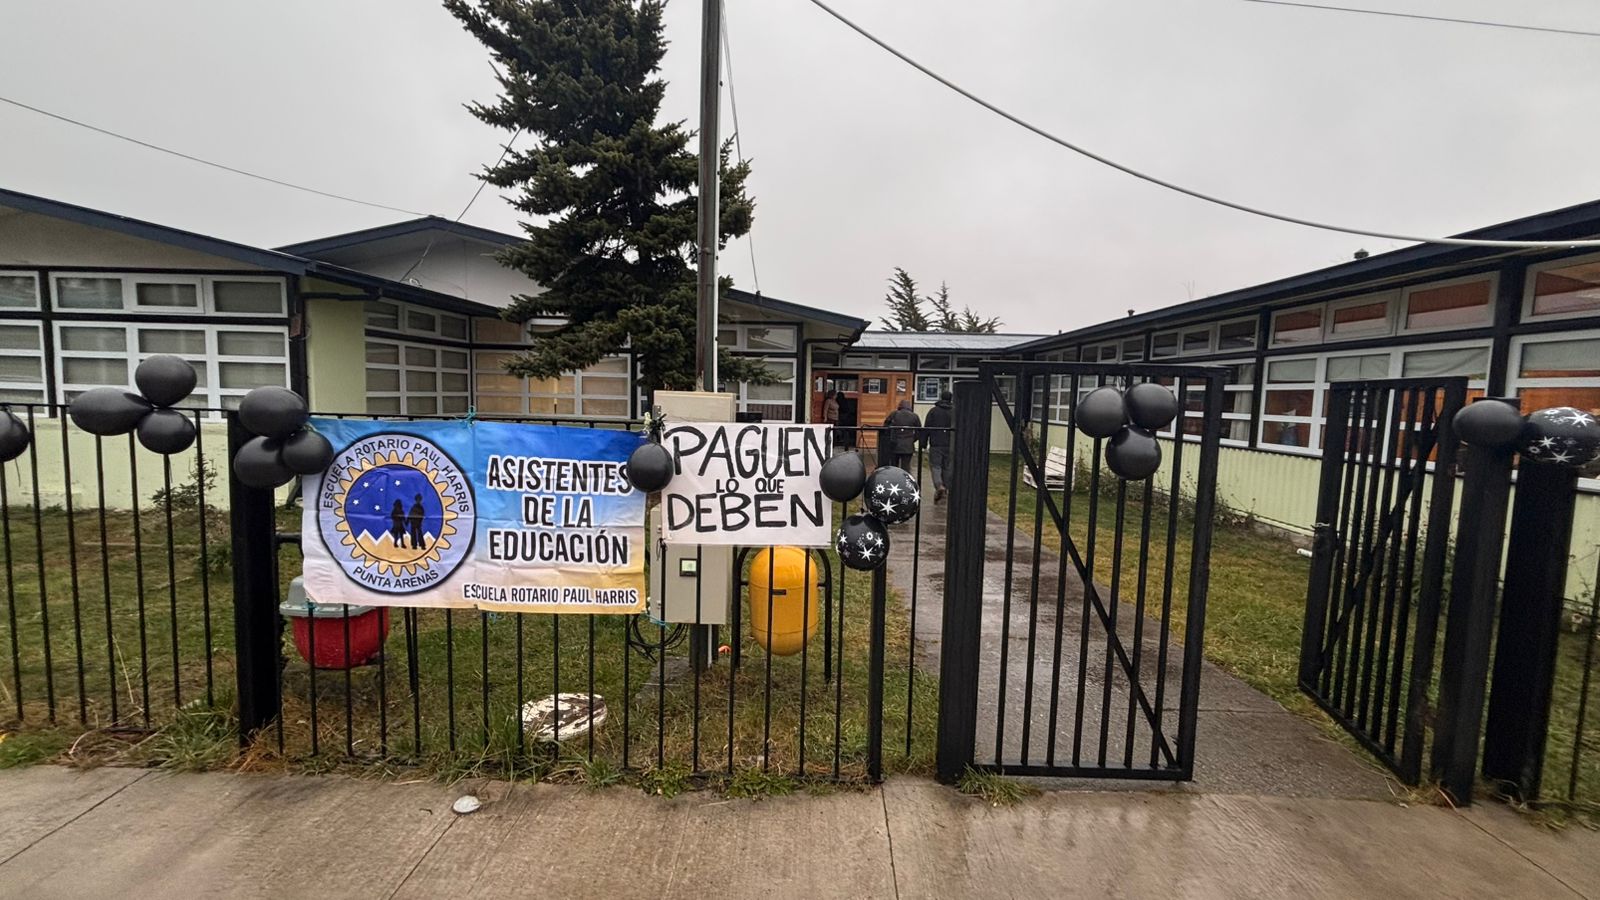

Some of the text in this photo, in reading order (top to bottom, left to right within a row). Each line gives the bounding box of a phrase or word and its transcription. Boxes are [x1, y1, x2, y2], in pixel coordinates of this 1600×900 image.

[664, 425, 832, 479] PAGUEN
[323, 438, 470, 513] ESCUELA ROTARIO PAUL HARRIS
[488, 457, 633, 494] ASISTENTES
[715, 477, 785, 493] LO QUE
[524, 496, 592, 528] DE LA
[667, 491, 824, 532] DEBEN
[489, 529, 628, 564] EDUCACIÓN
[353, 566, 439, 589] PUNTA ARENAS
[464, 584, 637, 604] ESCUELA ROTARIO PAUL HARRIS
